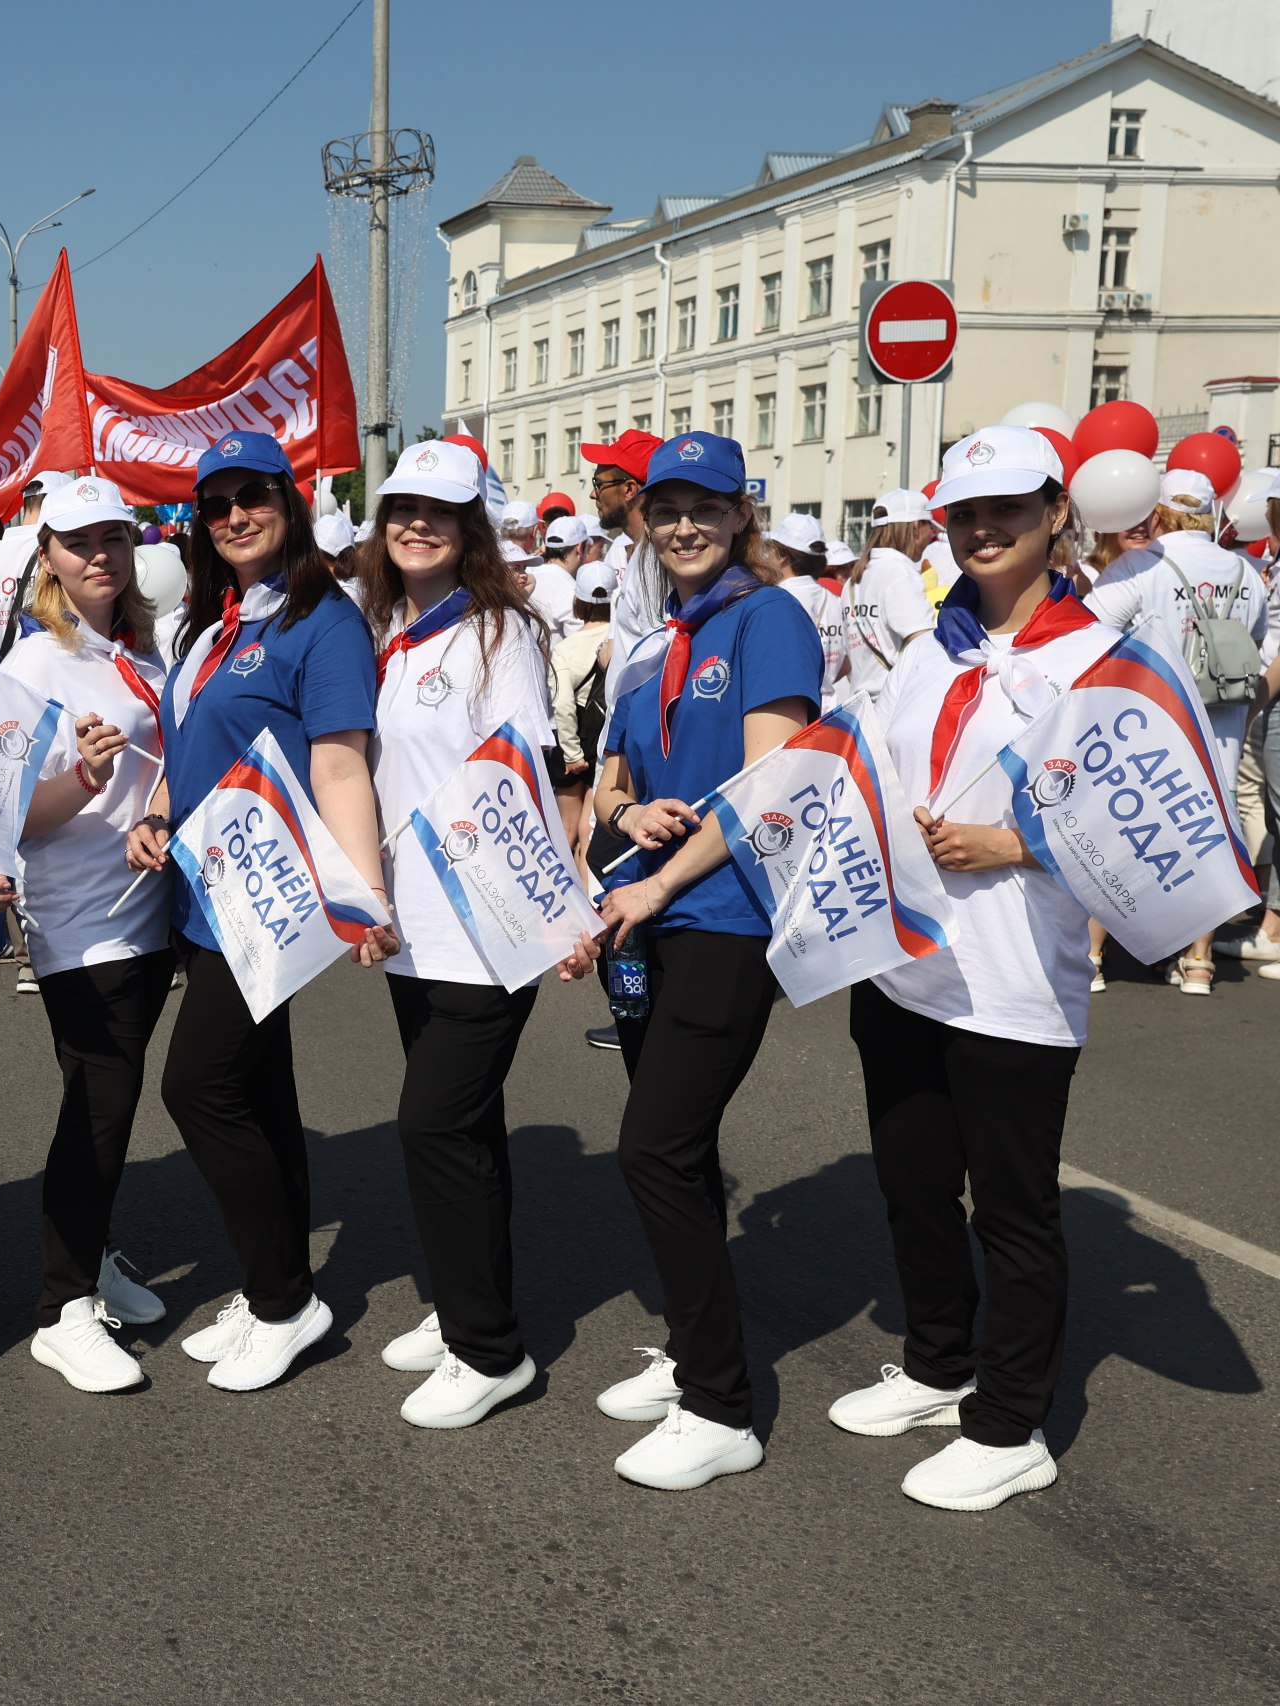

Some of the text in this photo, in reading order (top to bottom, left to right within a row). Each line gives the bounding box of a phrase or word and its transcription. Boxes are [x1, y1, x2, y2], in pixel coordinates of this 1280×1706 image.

[417, 666, 442, 687] ЗАРЯ
[497, 778, 514, 808] С
[1048, 760, 1075, 772] ЗАРЯ
[1113, 707, 1228, 860] С ДНЁМ
[453, 822, 476, 833] ЗАРЯ
[765, 812, 791, 826] ЗАРЯ
[1075, 722, 1196, 893] ГОРОДА!
[220, 818, 301, 950] ГОРОДА!
[244, 806, 320, 924] С ДНЁМ
[472, 791, 567, 924] ГОРОДА!
[782, 860, 799, 877] АО
[827, 776, 888, 919] С ДНЁМ
[1061, 810, 1138, 914] АО ДЗХО «ЗАРЯ»
[471, 864, 486, 880] АО
[481, 881, 506, 909] ДЗХО
